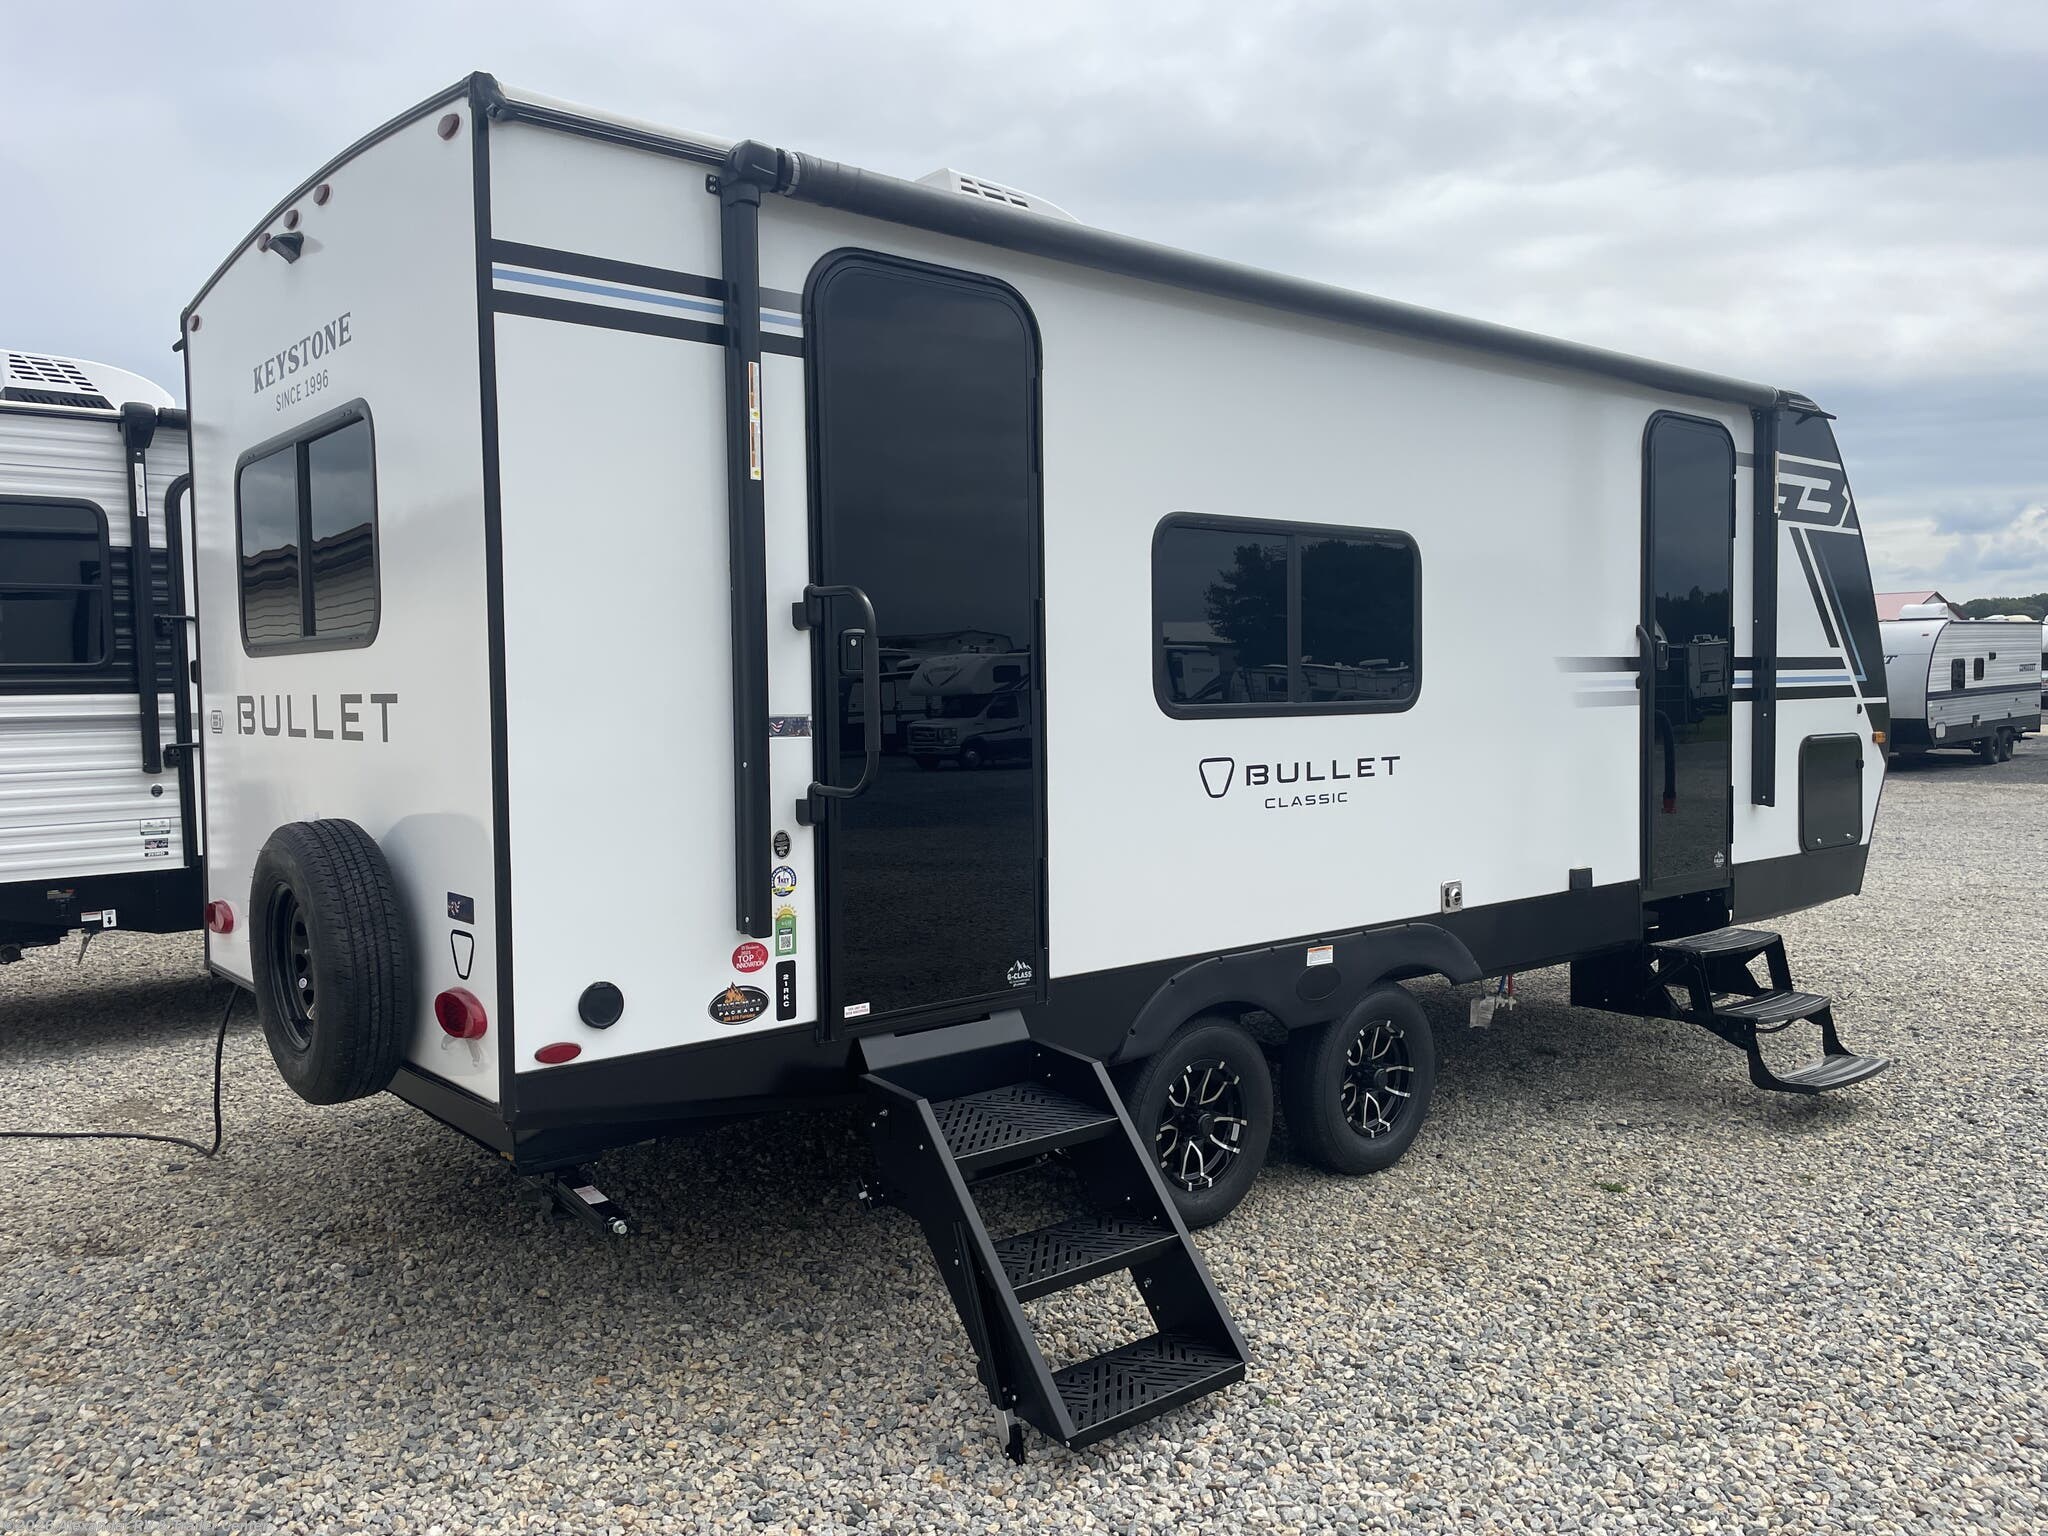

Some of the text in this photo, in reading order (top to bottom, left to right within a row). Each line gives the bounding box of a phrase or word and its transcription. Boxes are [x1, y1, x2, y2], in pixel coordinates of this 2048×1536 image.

[253, 311, 352, 394] KEYSTONE
[276, 369, 329, 412] SINCE 1996
[236, 693, 398, 743] BULLET
[1245, 755, 1401, 786] BULLET
[1264, 791, 1348, 809] CLASSIC
[735, 959, 765, 969] INNOVATION
[737, 954, 755, 963] TOP
[718, 1006, 760, 1017] PACKAGE
